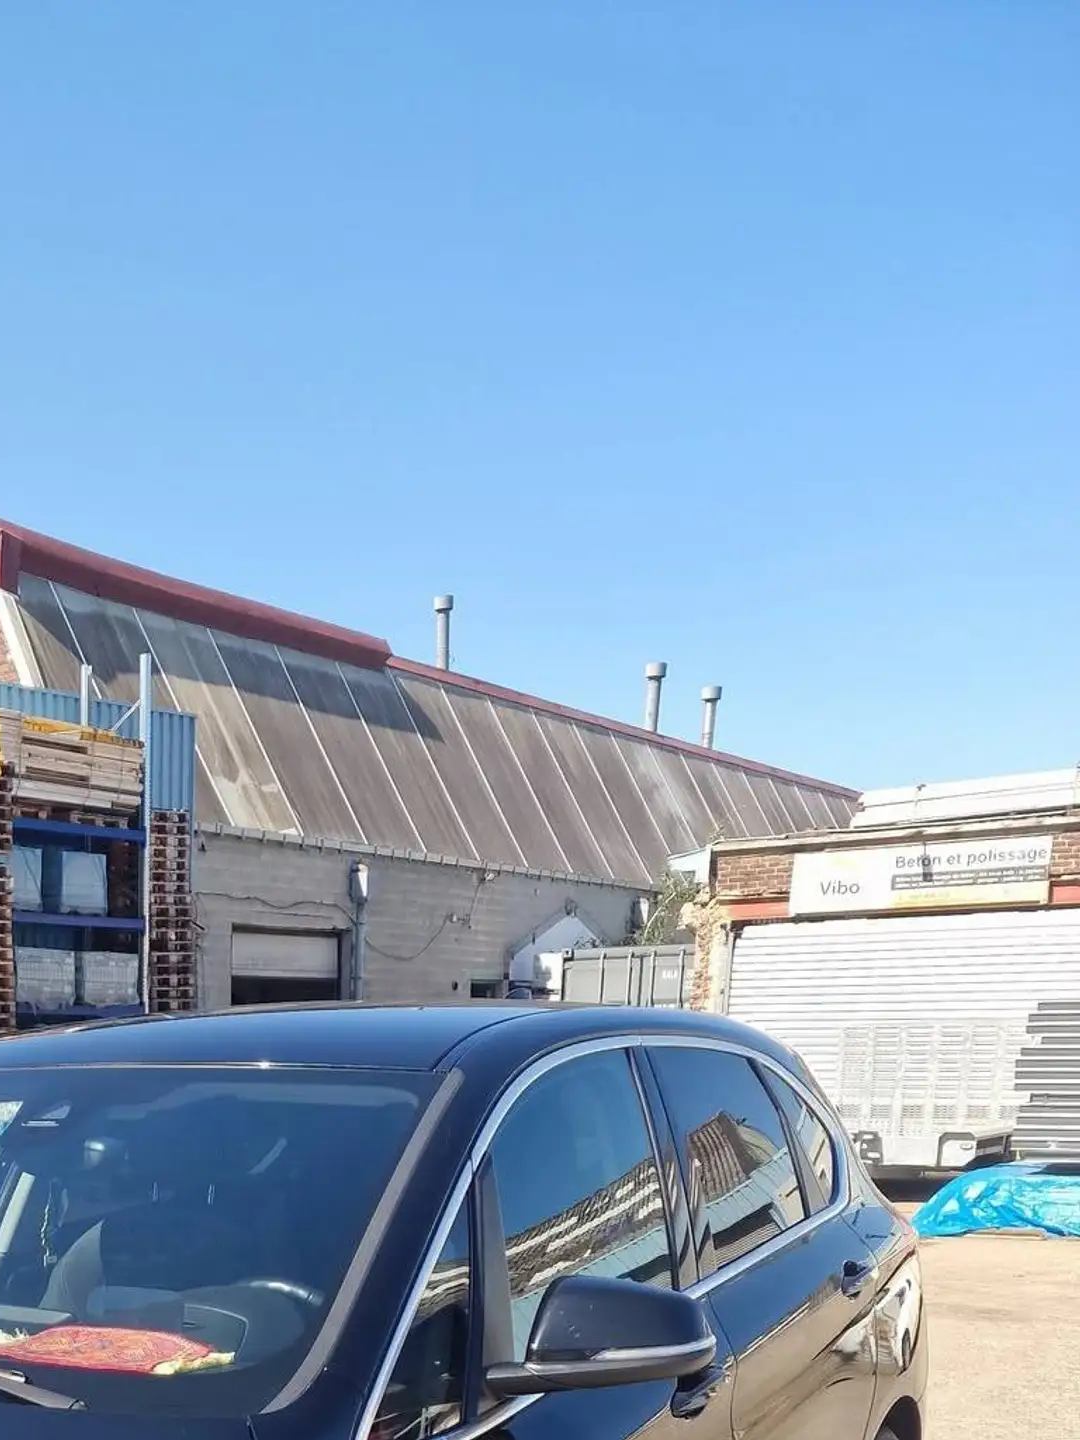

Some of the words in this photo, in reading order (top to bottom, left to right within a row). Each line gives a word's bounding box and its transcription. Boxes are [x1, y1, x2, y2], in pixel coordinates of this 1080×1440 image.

[946, 854, 962, 866] et
[967, 849, 1048, 866] polissage
[820, 880, 860, 896] Vibo
